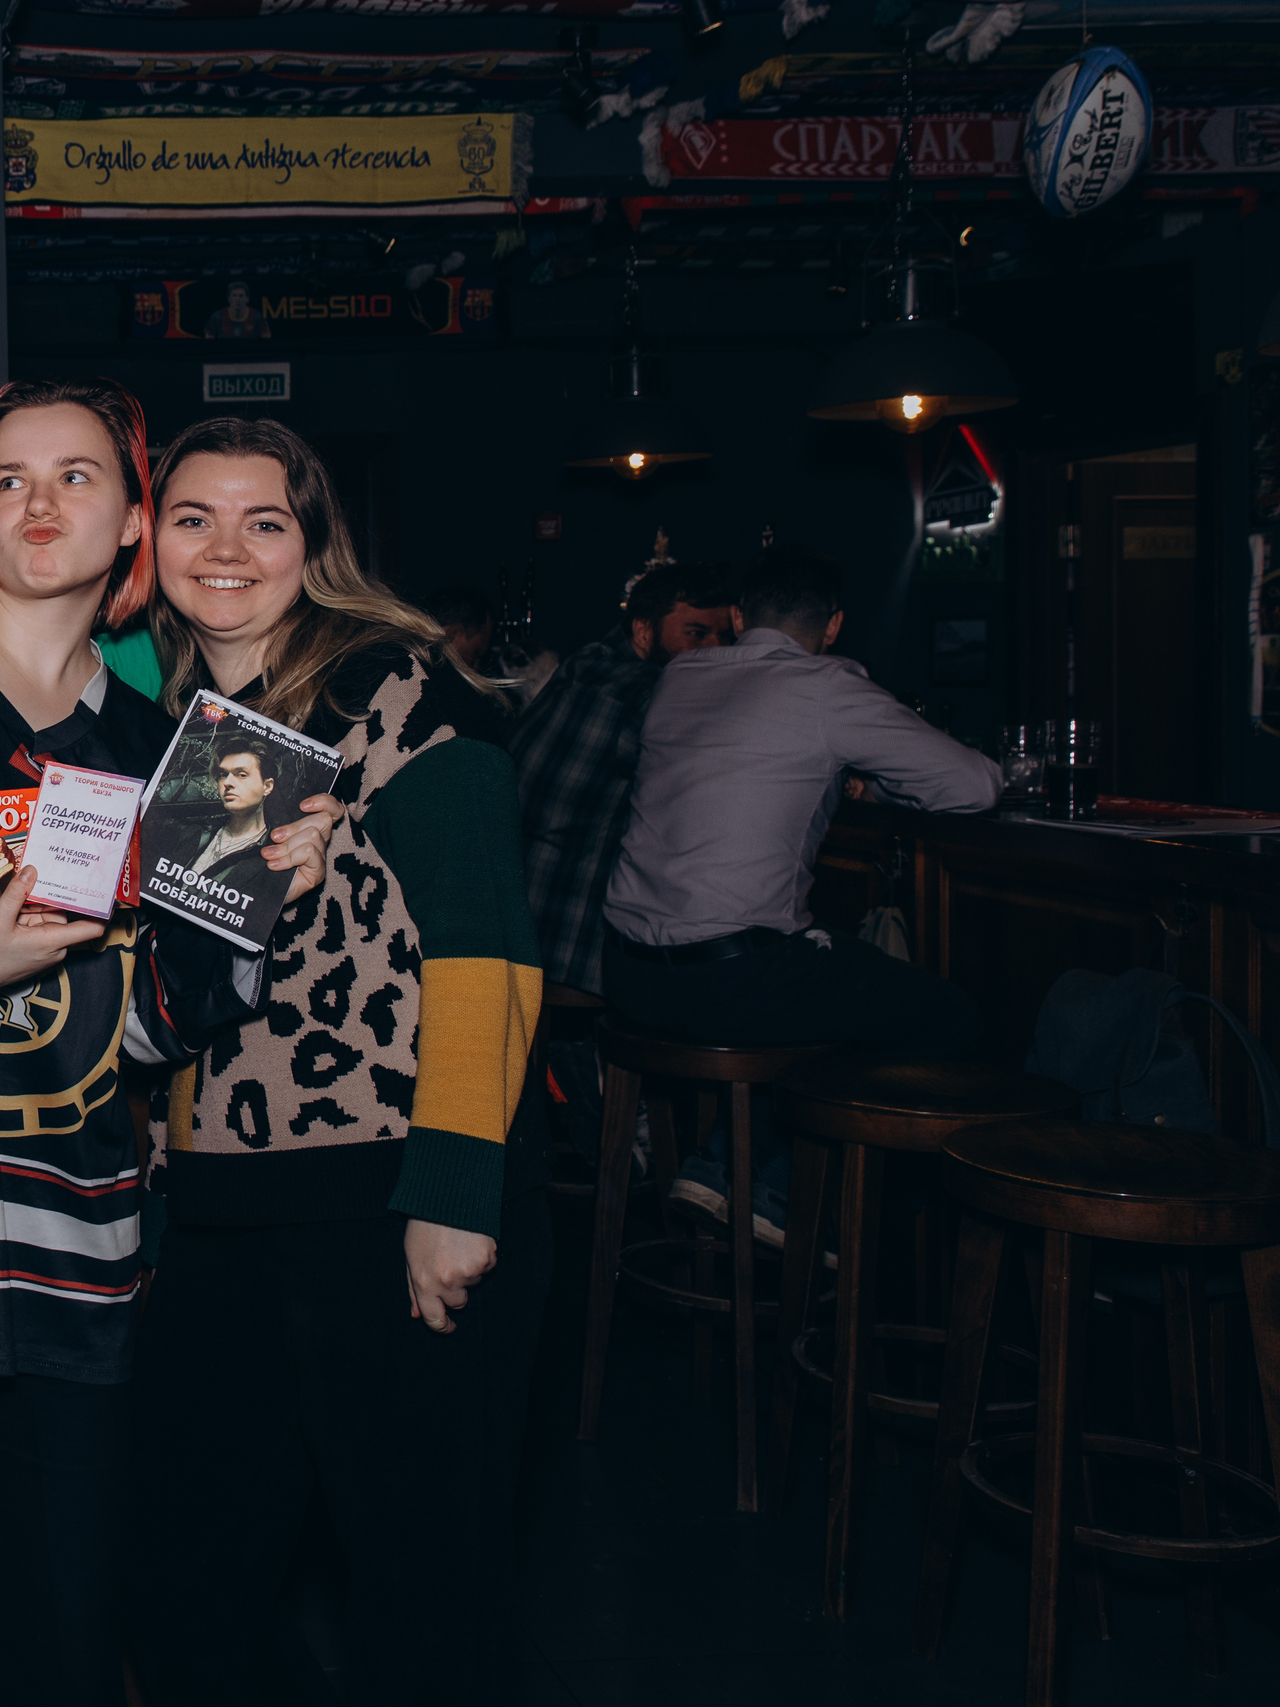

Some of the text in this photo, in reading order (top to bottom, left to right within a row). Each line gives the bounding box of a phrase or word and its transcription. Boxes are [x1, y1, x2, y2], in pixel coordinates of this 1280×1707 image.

[773, 122, 970, 162] СПАРТАК
[1074, 89, 1125, 209] GILBERT
[64, 140, 431, 184] Orgullo de una Antigua Herencia
[211, 377, 282, 395] ВЫХОД
[206, 708, 221, 718] ТБК
[237, 719, 339, 770] ТЕОРИЯ БОЛЬШОГО КВИЗА
[74, 776, 135, 793] ТЕОРИЯ БОЛЬШОГО
[92, 788, 112, 797] КВИЗА
[41, 803, 127, 830] ПОДАРОЧНЫЙ
[41, 817, 121, 842] СЕРТИФИКАТ
[48, 845, 60, 853] НА
[65, 849, 101, 862] ЧЕЛОВЕКА
[54, 854, 66, 862] НА
[71, 858, 91, 868] ИГРУ
[122, 847, 131, 898] Choc
[155, 857, 254, 910] БЛОКНОТ
[148, 877, 245, 928] ПОБЕДИТЕЛЯ
